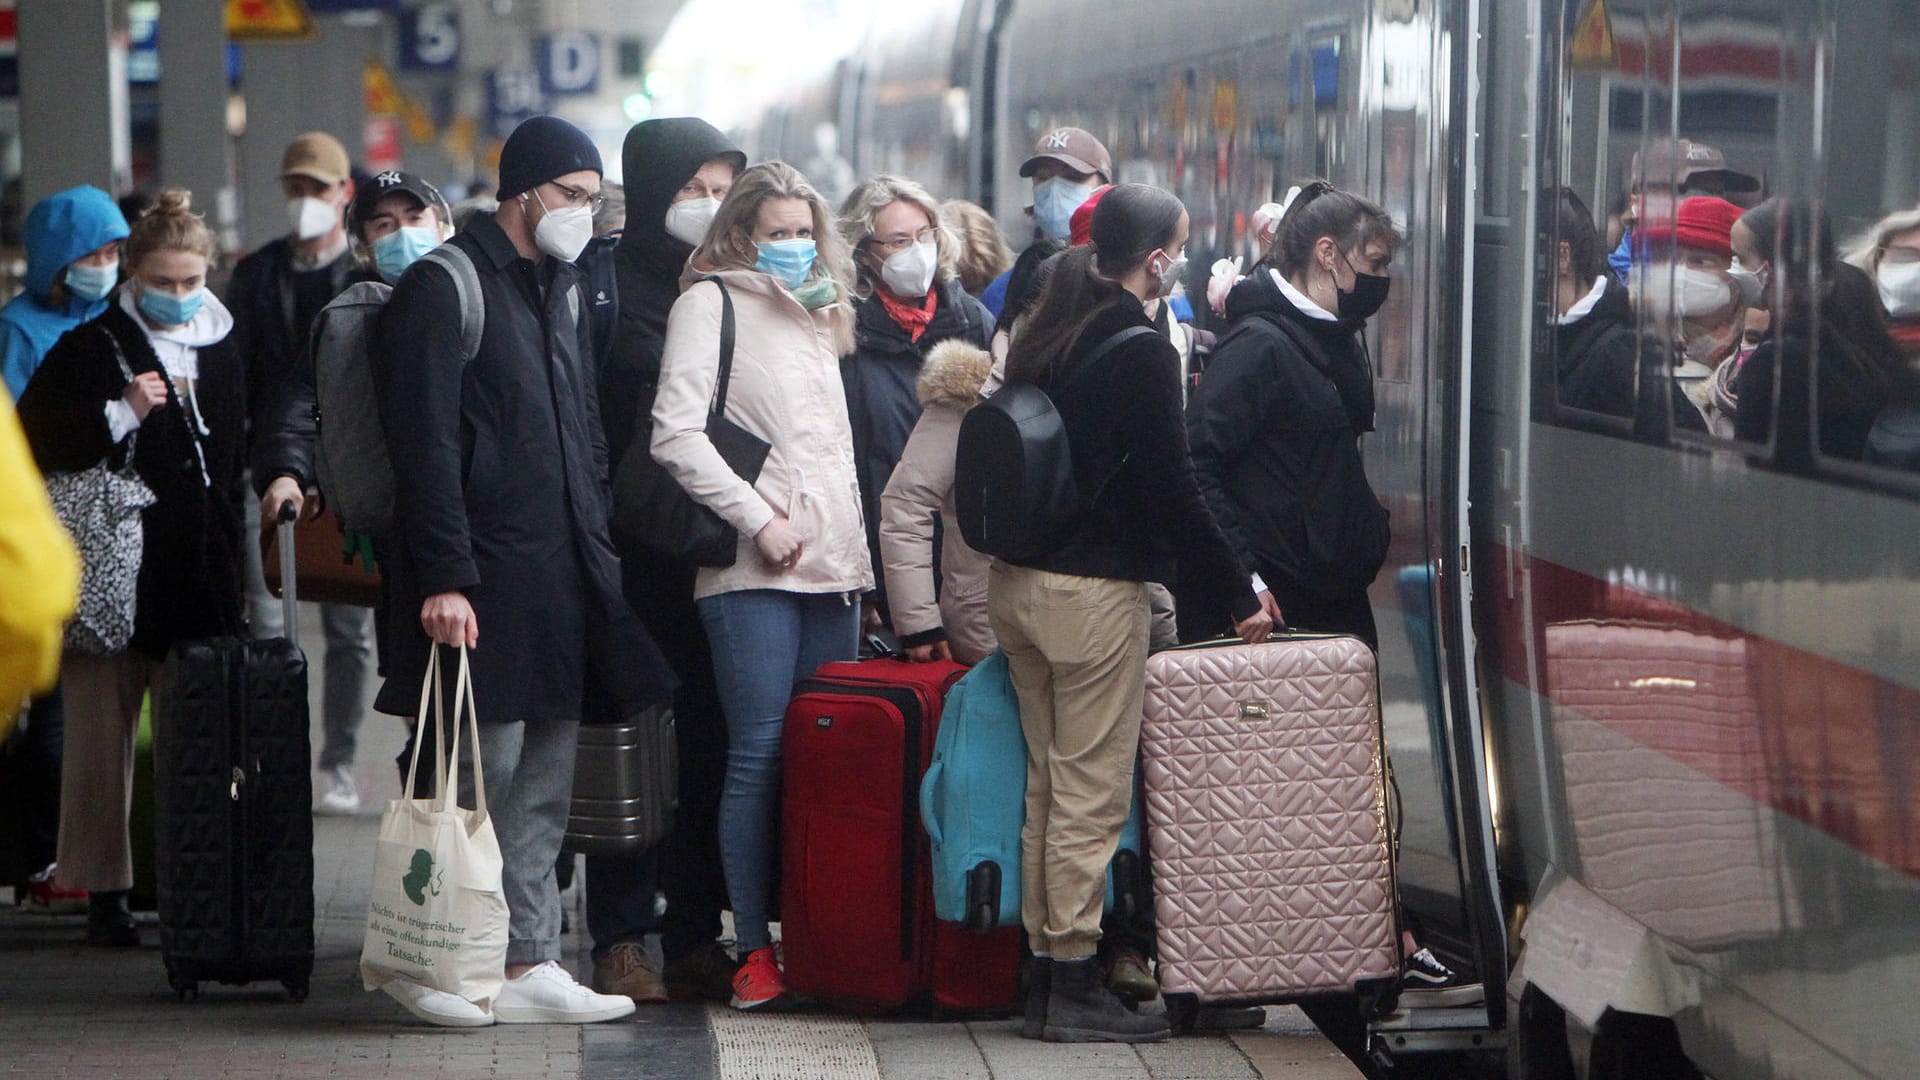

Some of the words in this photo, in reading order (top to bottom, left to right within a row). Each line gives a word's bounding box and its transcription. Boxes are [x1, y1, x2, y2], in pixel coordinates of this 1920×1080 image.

[551, 33, 597, 90] D
[1047, 131, 1070, 148] NY
[378, 170, 402, 187] NY
[371, 902, 394, 919] Nichts
[397, 911, 406, 923] ist
[409, 917, 466, 934] trügerischer
[370, 920, 379, 931] als
[382, 927, 397, 937] eine
[400, 931, 460, 951] offenkundige
[387, 941, 434, 966] Tatsache.
